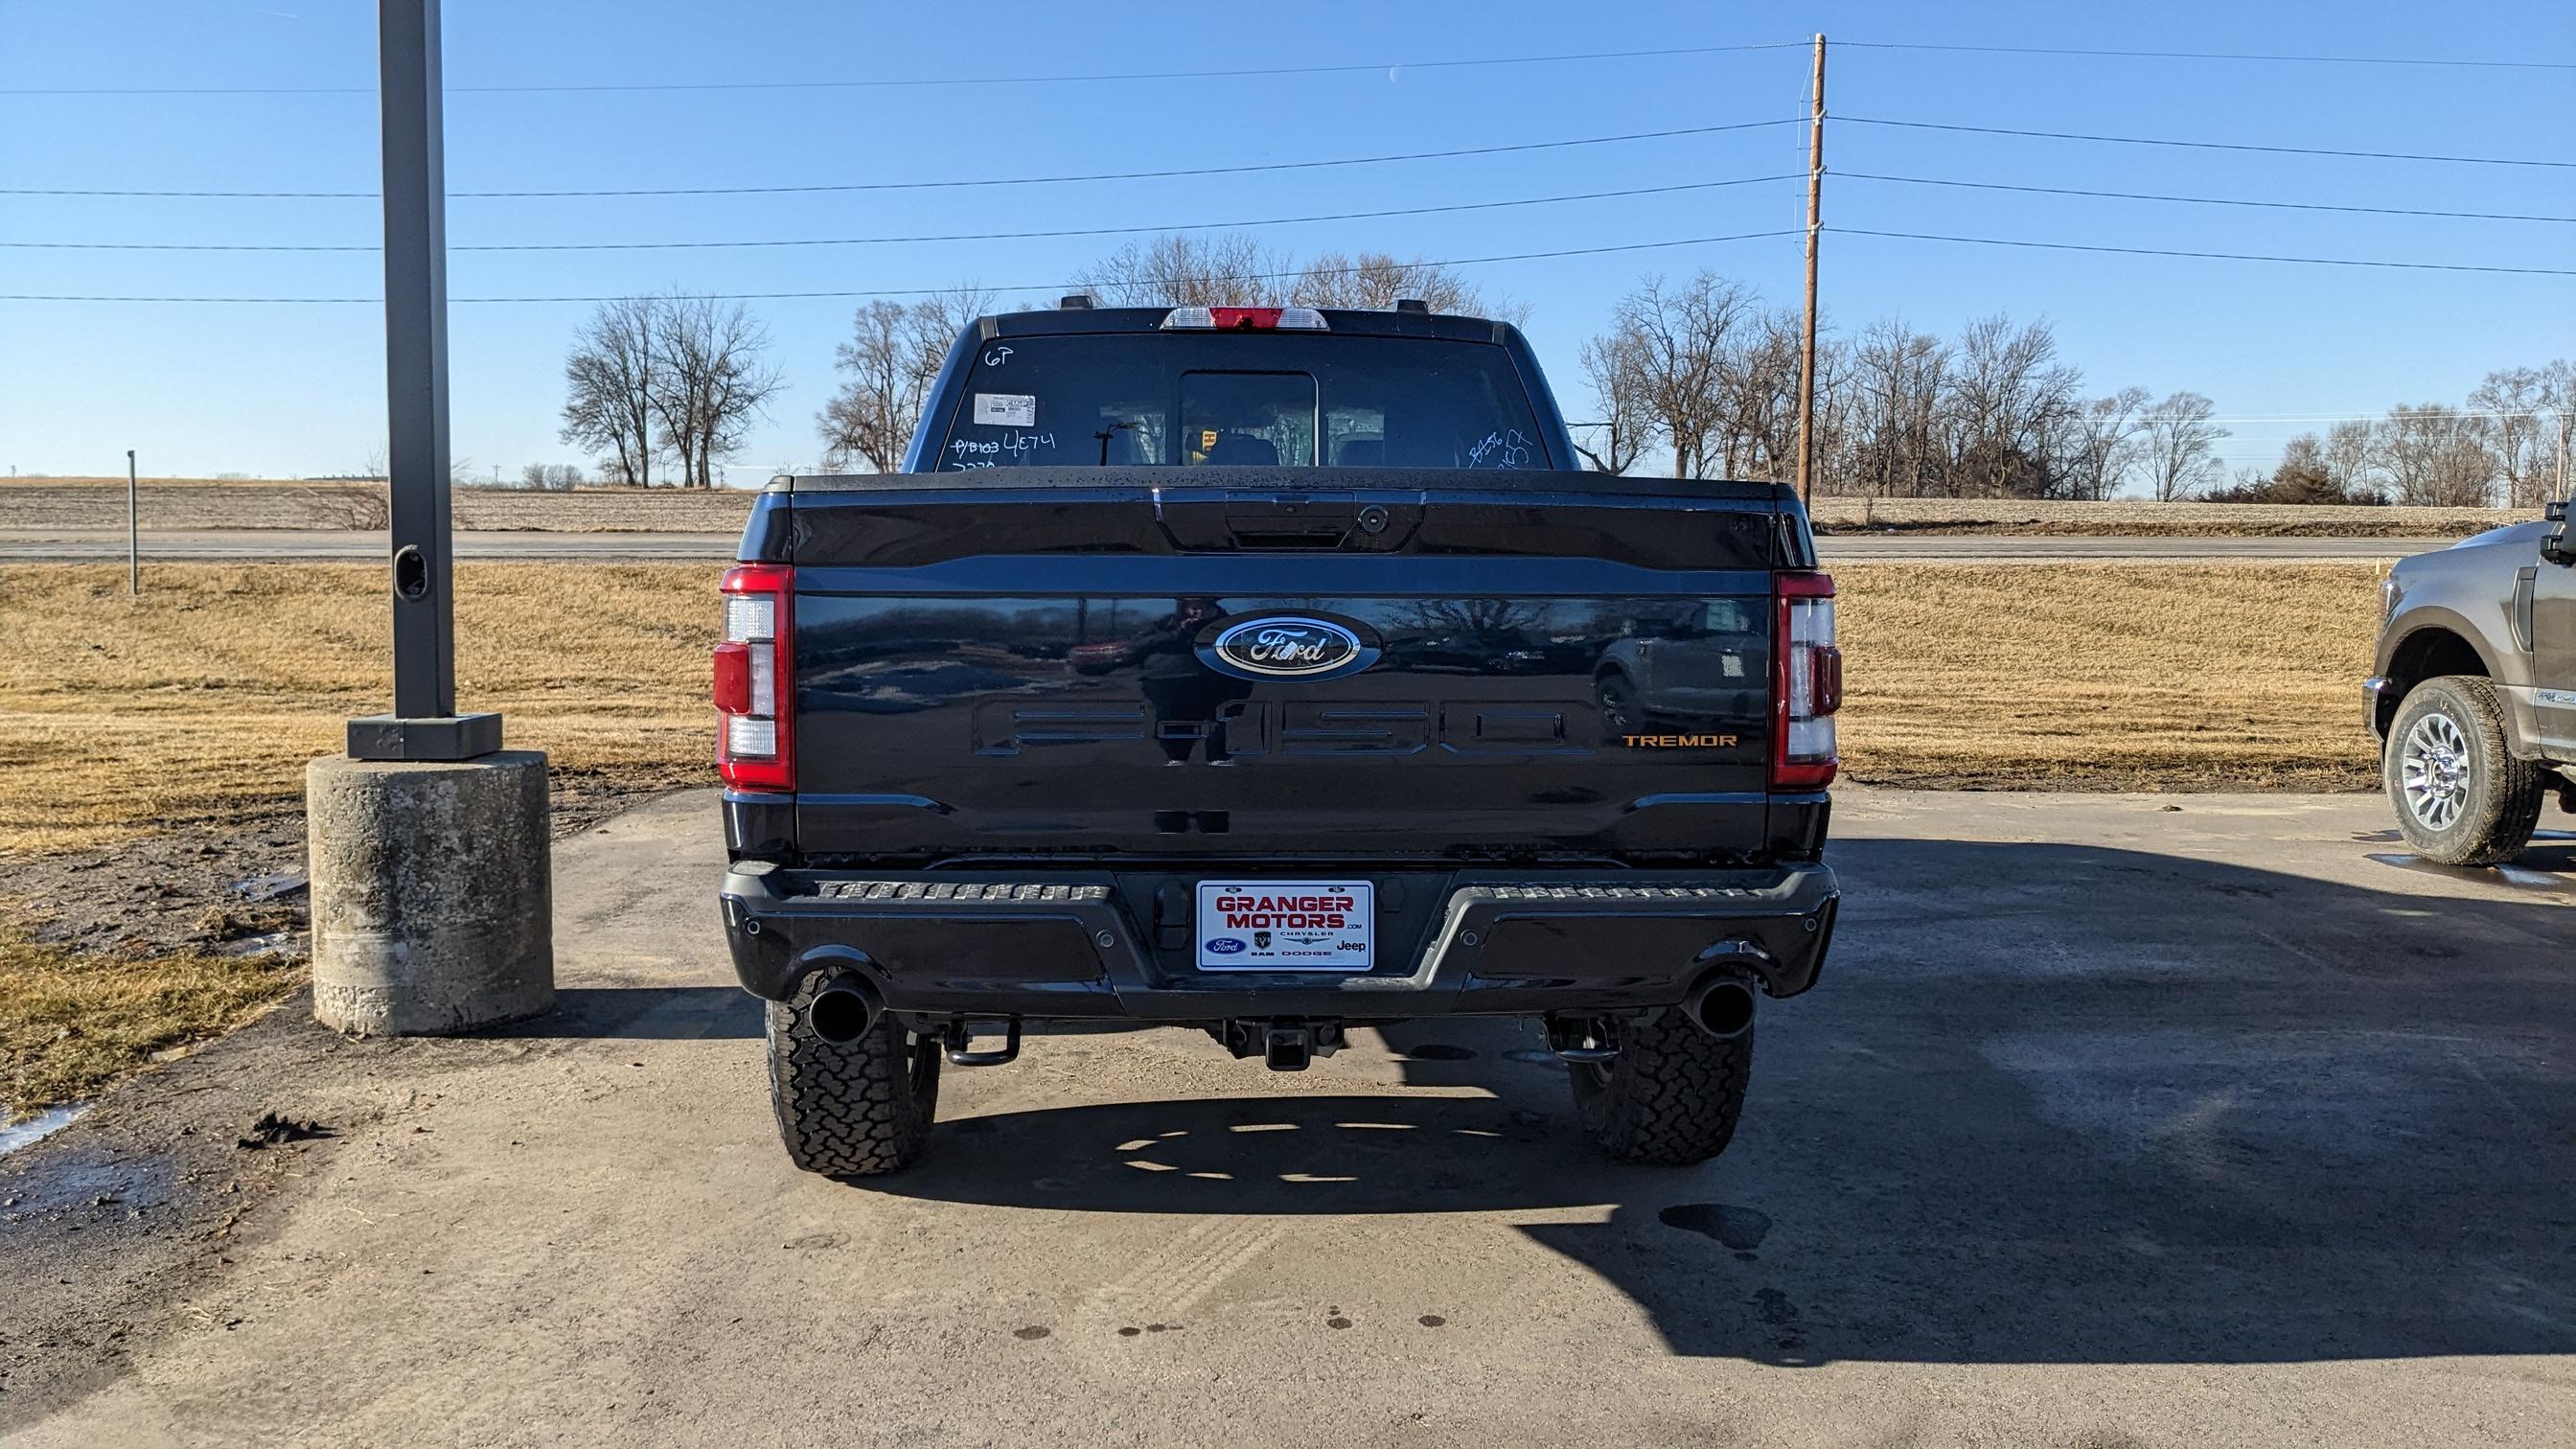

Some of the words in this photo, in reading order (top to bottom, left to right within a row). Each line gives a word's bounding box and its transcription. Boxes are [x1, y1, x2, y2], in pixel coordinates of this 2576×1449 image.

[1250, 629, 1327, 661] Ford
[1622, 735, 1737, 747] TREMOR
[1216, 896, 1354, 912] GRANGER
[1227, 913, 1346, 929] MOTORS
[1212, 939, 1238, 952] Ford
[1336, 940, 1366, 953] Jeep
